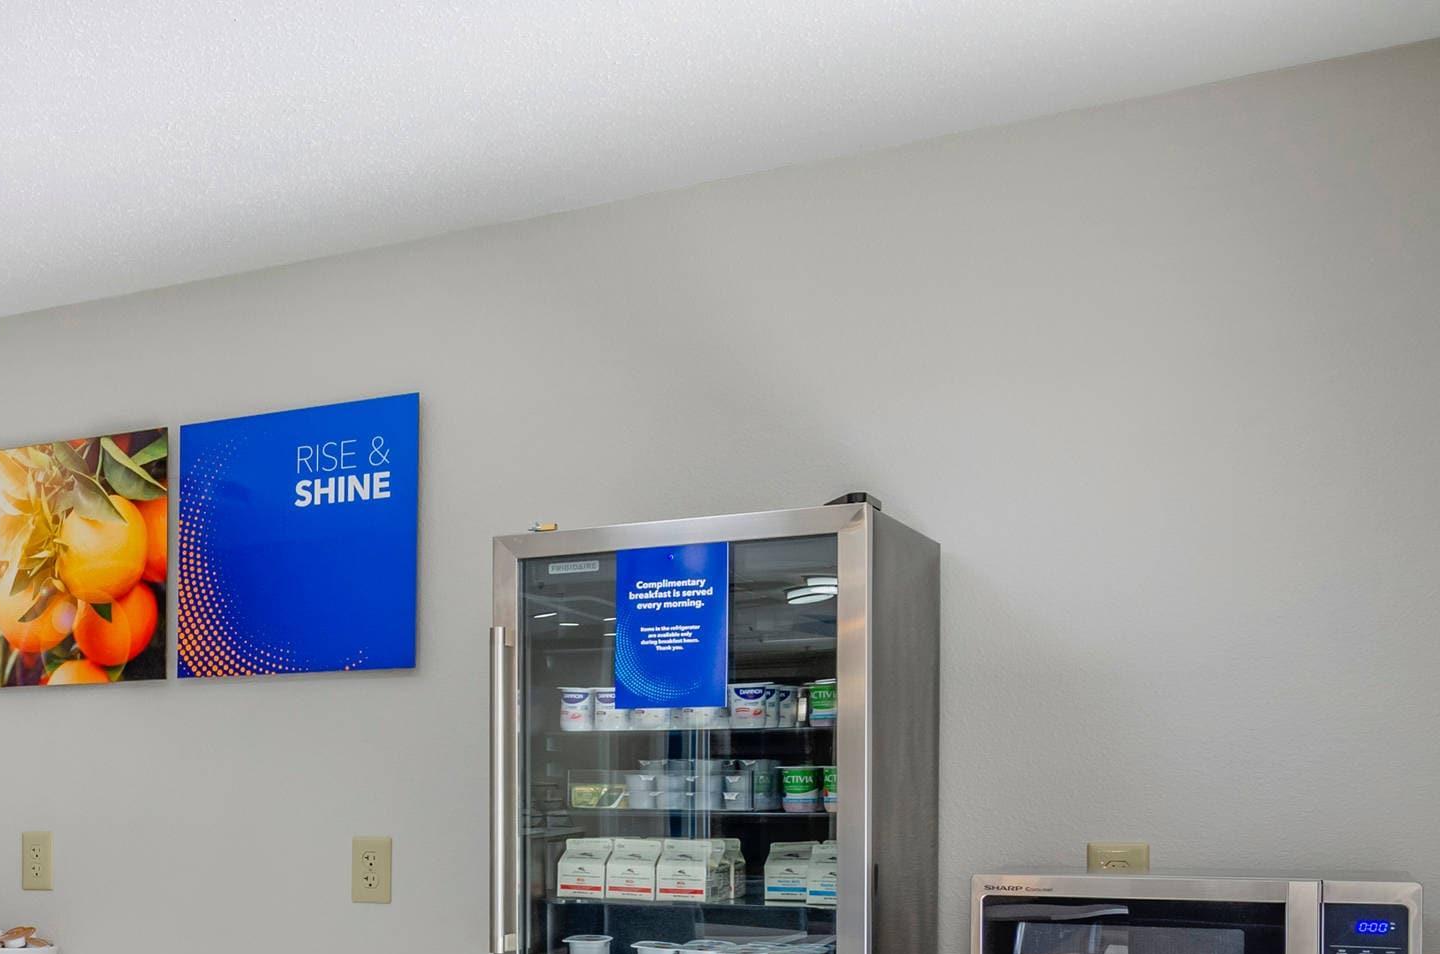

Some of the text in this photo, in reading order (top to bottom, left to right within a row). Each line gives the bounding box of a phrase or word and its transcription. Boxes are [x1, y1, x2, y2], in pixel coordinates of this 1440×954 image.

[296, 435, 390, 474] RISE &
[294, 471, 391, 507] SHINE
[636, 578, 706, 590] Complimentary
[629, 586, 714, 600] breakfast is served
[636, 598, 705, 611] every morning.
